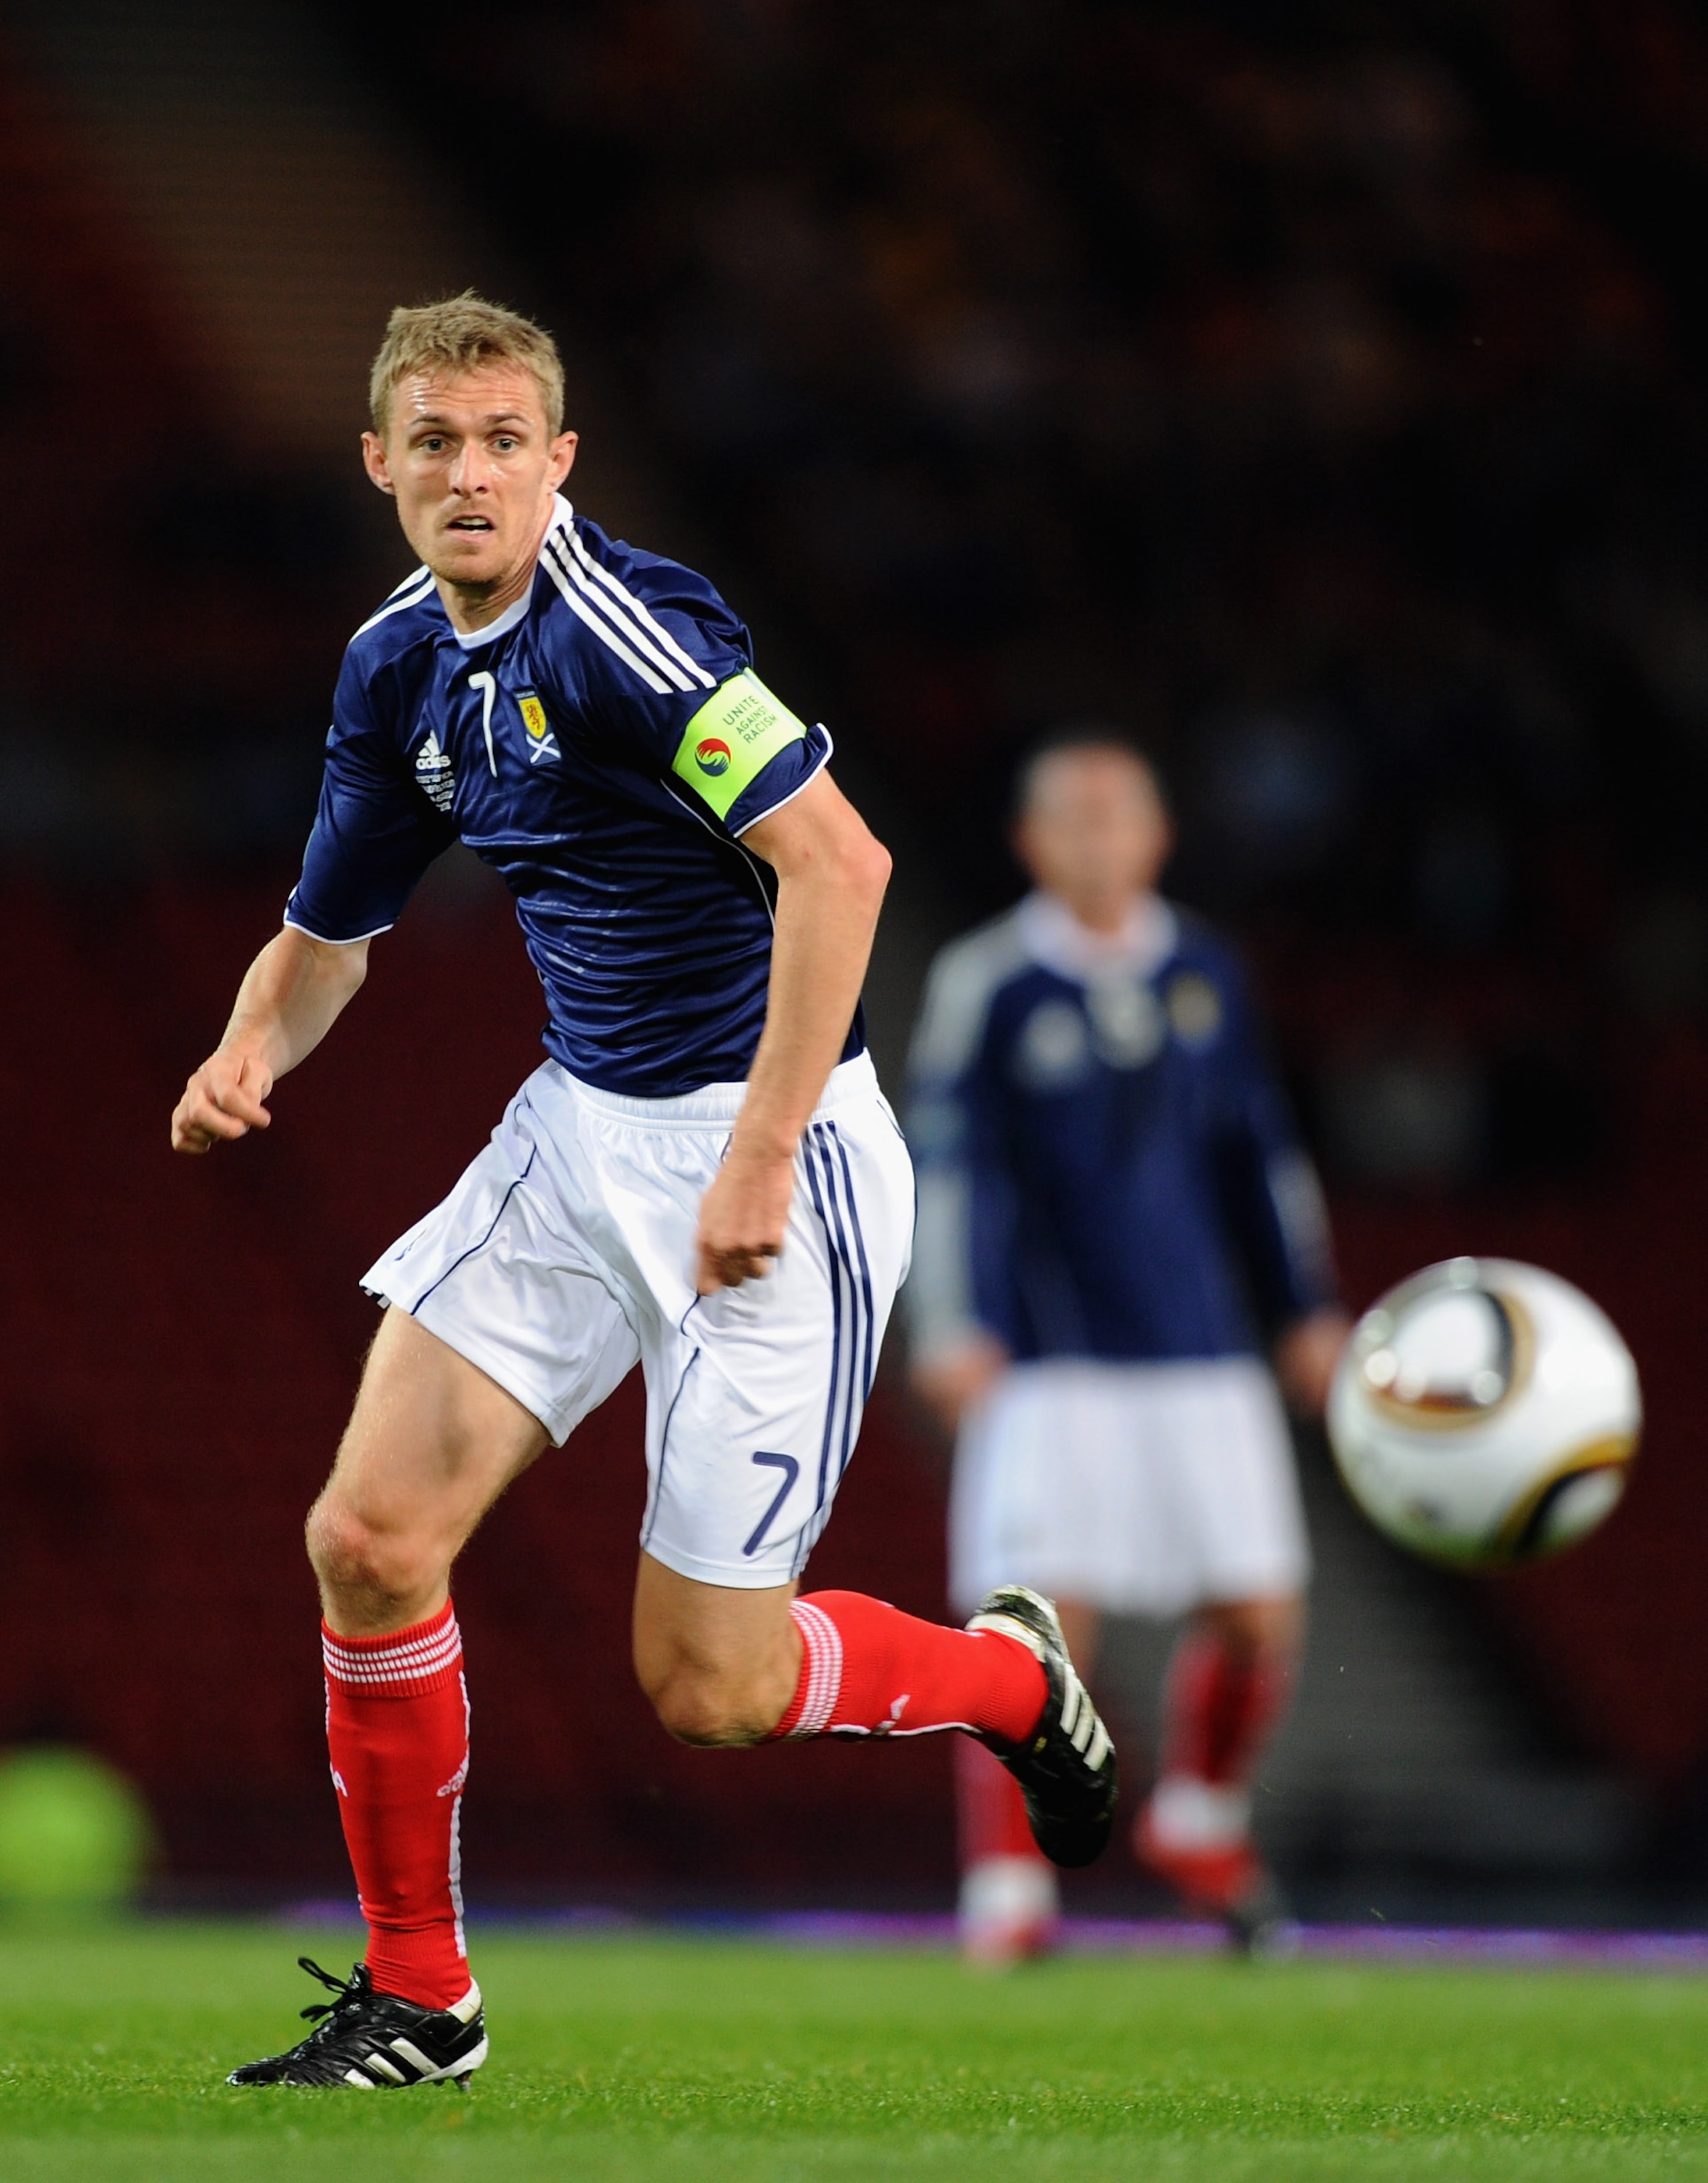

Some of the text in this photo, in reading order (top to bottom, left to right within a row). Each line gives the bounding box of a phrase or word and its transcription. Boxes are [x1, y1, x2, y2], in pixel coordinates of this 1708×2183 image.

[468, 670, 497, 778] 7
[723, 695, 760, 725] UNITE
[742, 1451, 799, 1556] 7
